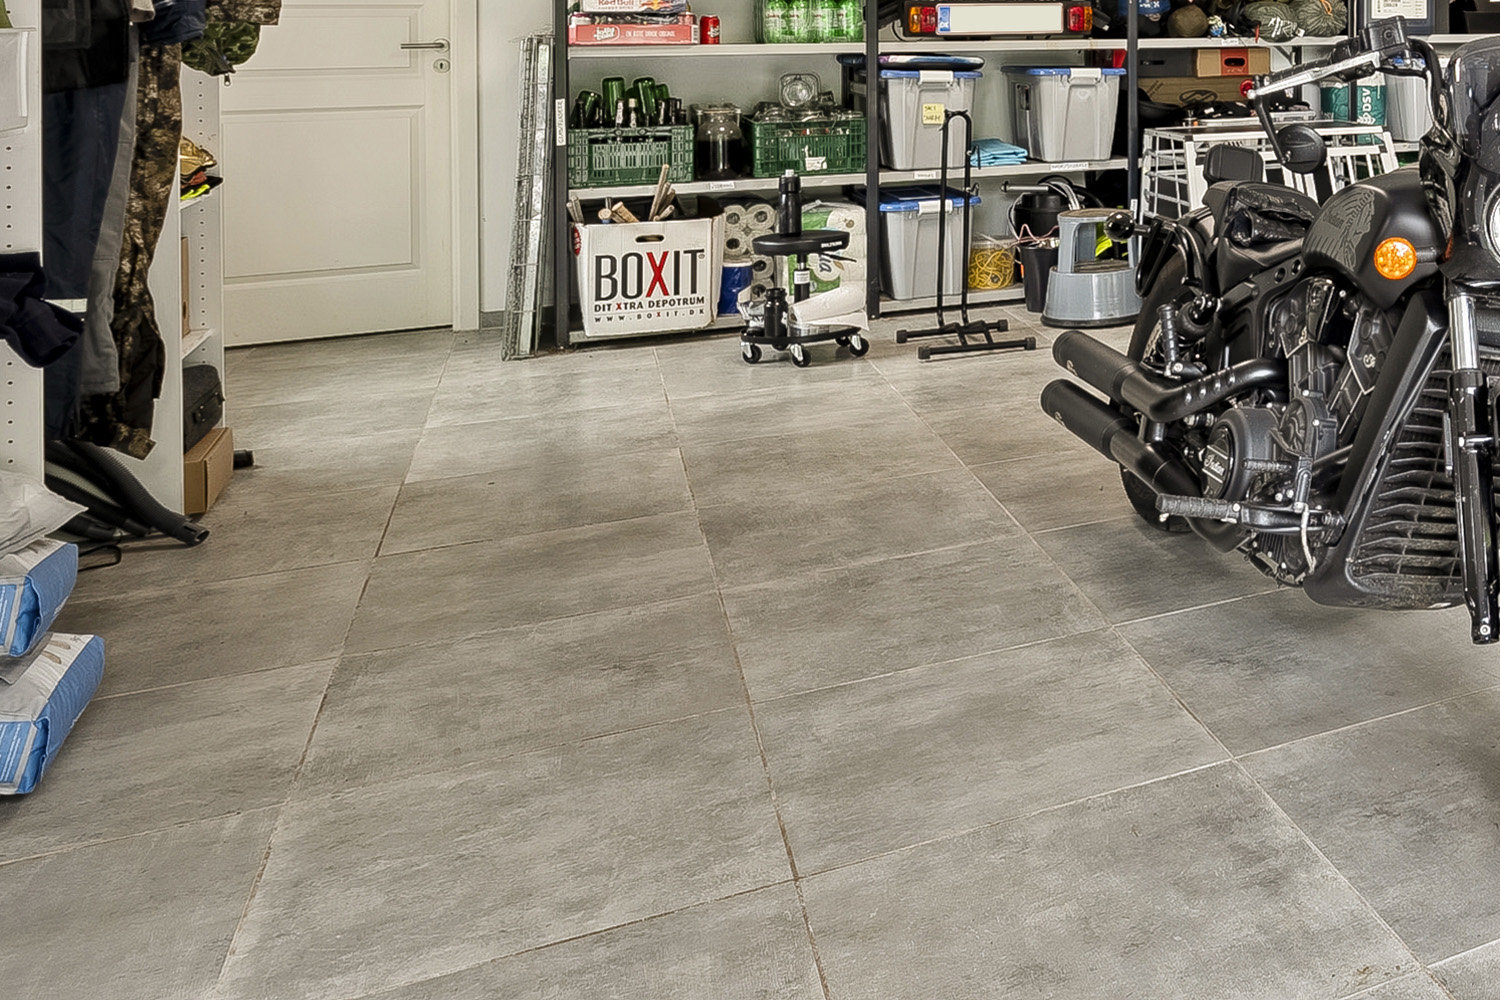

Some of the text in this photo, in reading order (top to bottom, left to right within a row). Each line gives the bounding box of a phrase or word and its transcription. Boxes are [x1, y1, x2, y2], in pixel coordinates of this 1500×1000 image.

[1362, 88, 1372, 112] DSV
[595, 249, 705, 301] BOXIT
[594, 297, 705, 313] DIT XTRA DEPOTRUM
